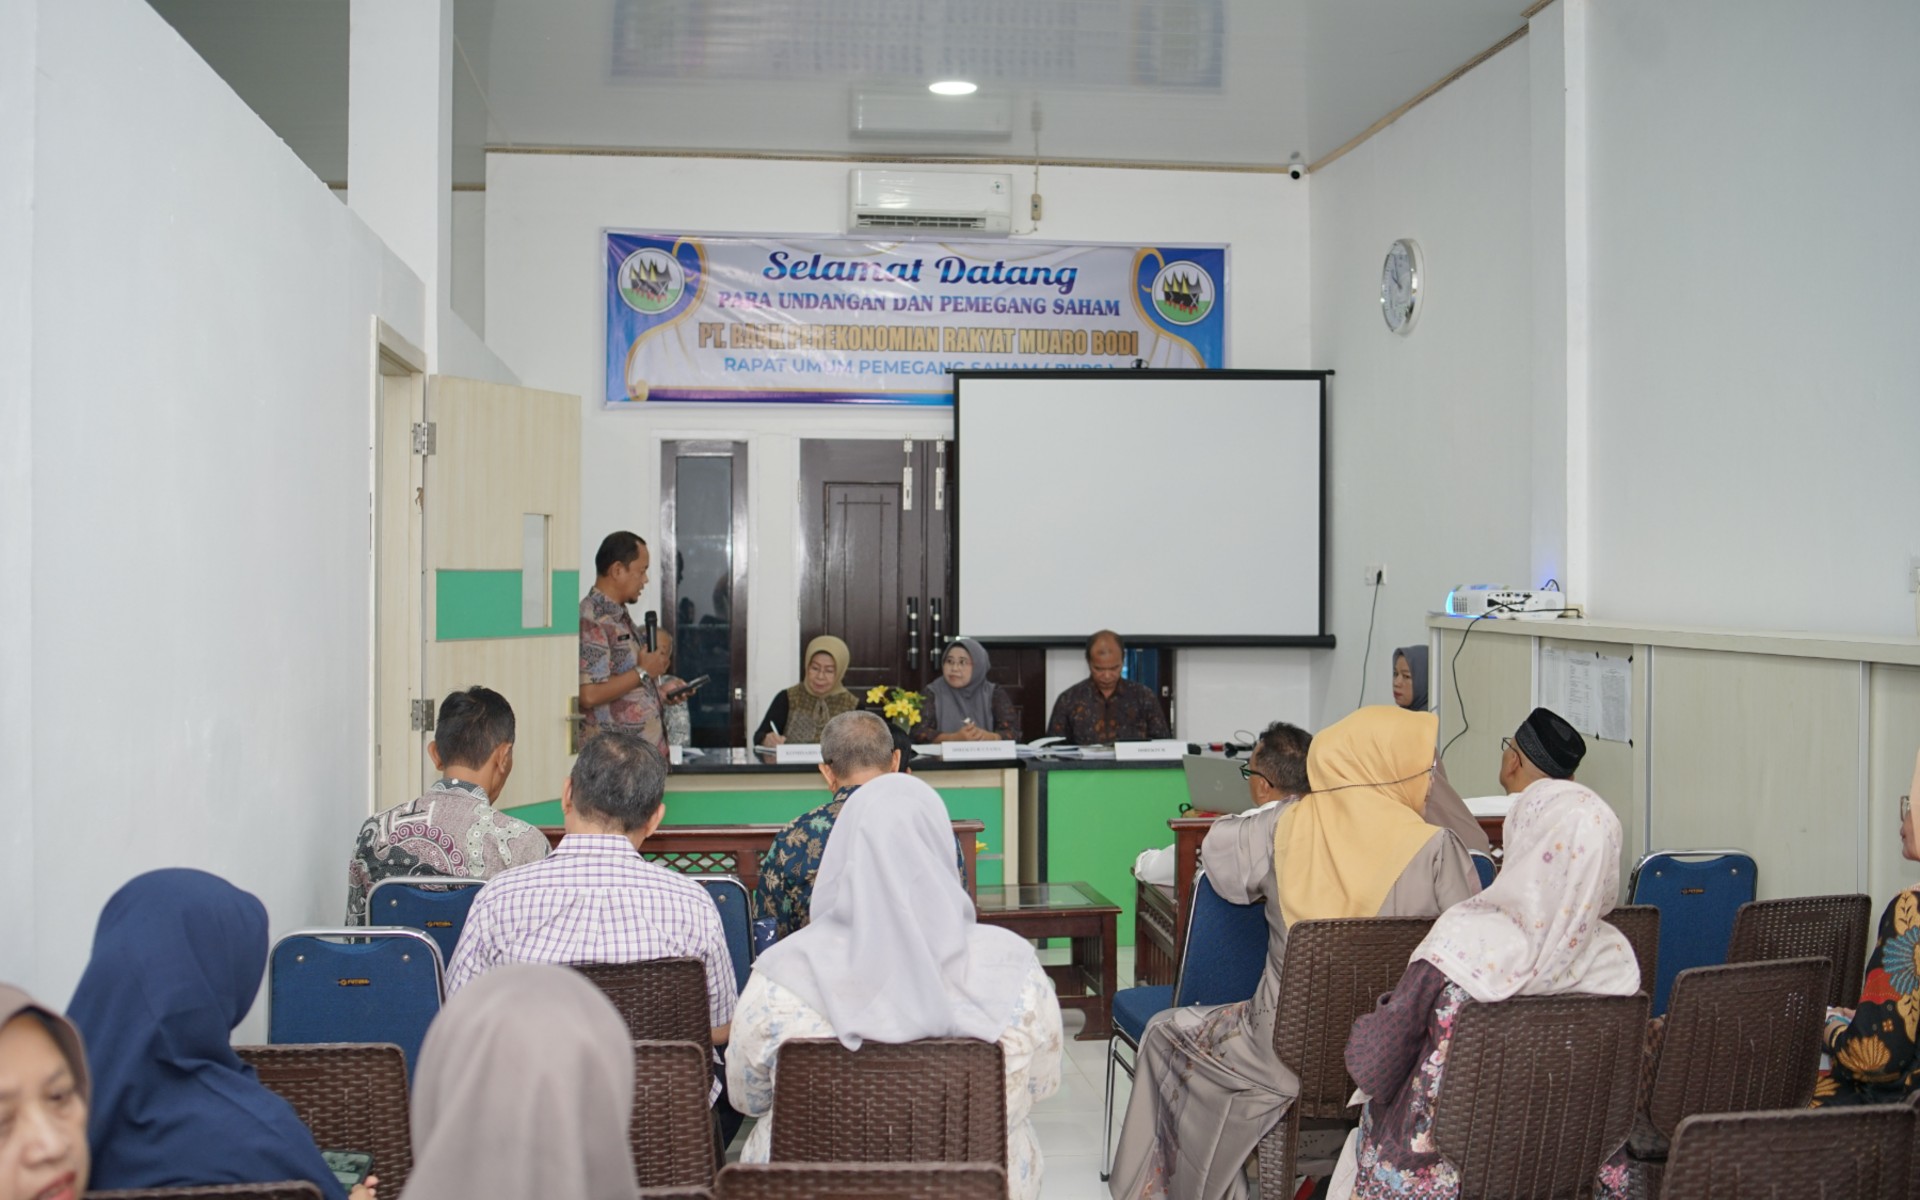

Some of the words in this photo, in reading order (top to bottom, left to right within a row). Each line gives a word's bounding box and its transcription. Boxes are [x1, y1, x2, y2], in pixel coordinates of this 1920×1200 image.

[762, 251, 924, 283] Selamat
[935, 256, 1078, 295] Datang
[718, 291, 772, 308] PARA
[778, 292, 886, 311] UNDANGAN
[893, 294, 933, 312] DAN
[940, 295, 1047, 315] PEMEGANG
[1052, 298, 1121, 316] SAHAM
[698, 322, 728, 348] PT.
[787, 323, 940, 352] PEREKONOMIAN
[943, 326, 1016, 353] RAKYAT
[1018, 328, 1089, 355] MUARO
[1091, 330, 1139, 356] BODI
[724, 357, 786, 372] RAPAT
[793, 358, 853, 374] UMUM
